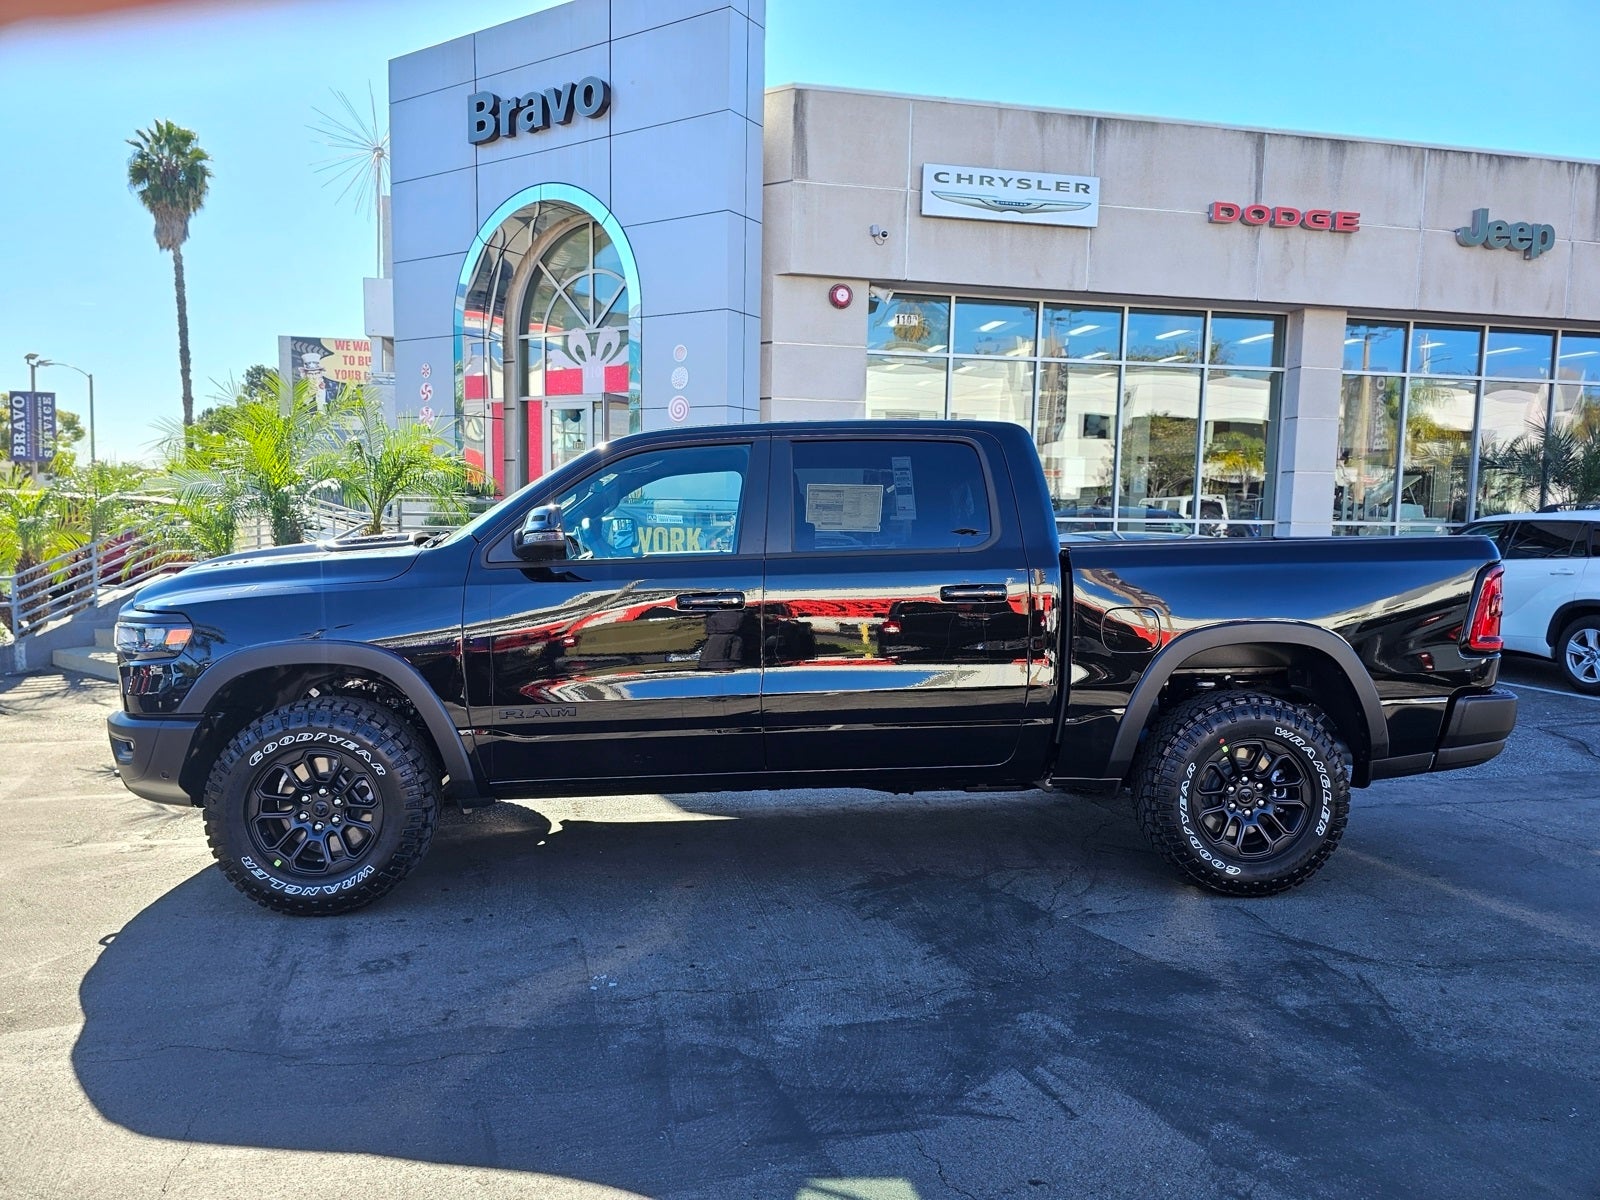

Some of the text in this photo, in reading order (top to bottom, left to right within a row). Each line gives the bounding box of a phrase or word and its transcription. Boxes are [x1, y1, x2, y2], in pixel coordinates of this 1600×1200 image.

[467, 75, 611, 145] Bravo
[933, 171, 1091, 195] CHRYSLER
[1208, 201, 1361, 234] DODGE
[1455, 207, 1556, 261] Jeep
[334, 340, 371, 352] WE WA
[342, 355, 356, 366] TO
[334, 369, 361, 381] YOUR
[12, 396, 26, 457] BRAVO
[43, 396, 54, 459] SERVICE
[499, 706, 577, 720] RAM
[249, 732, 387, 776] GOODYEAR
[1274, 726, 1332, 837] WRANGLER
[1179, 761, 1242, 876] GOODYEAR
[241, 855, 376, 896] WRANGLER
